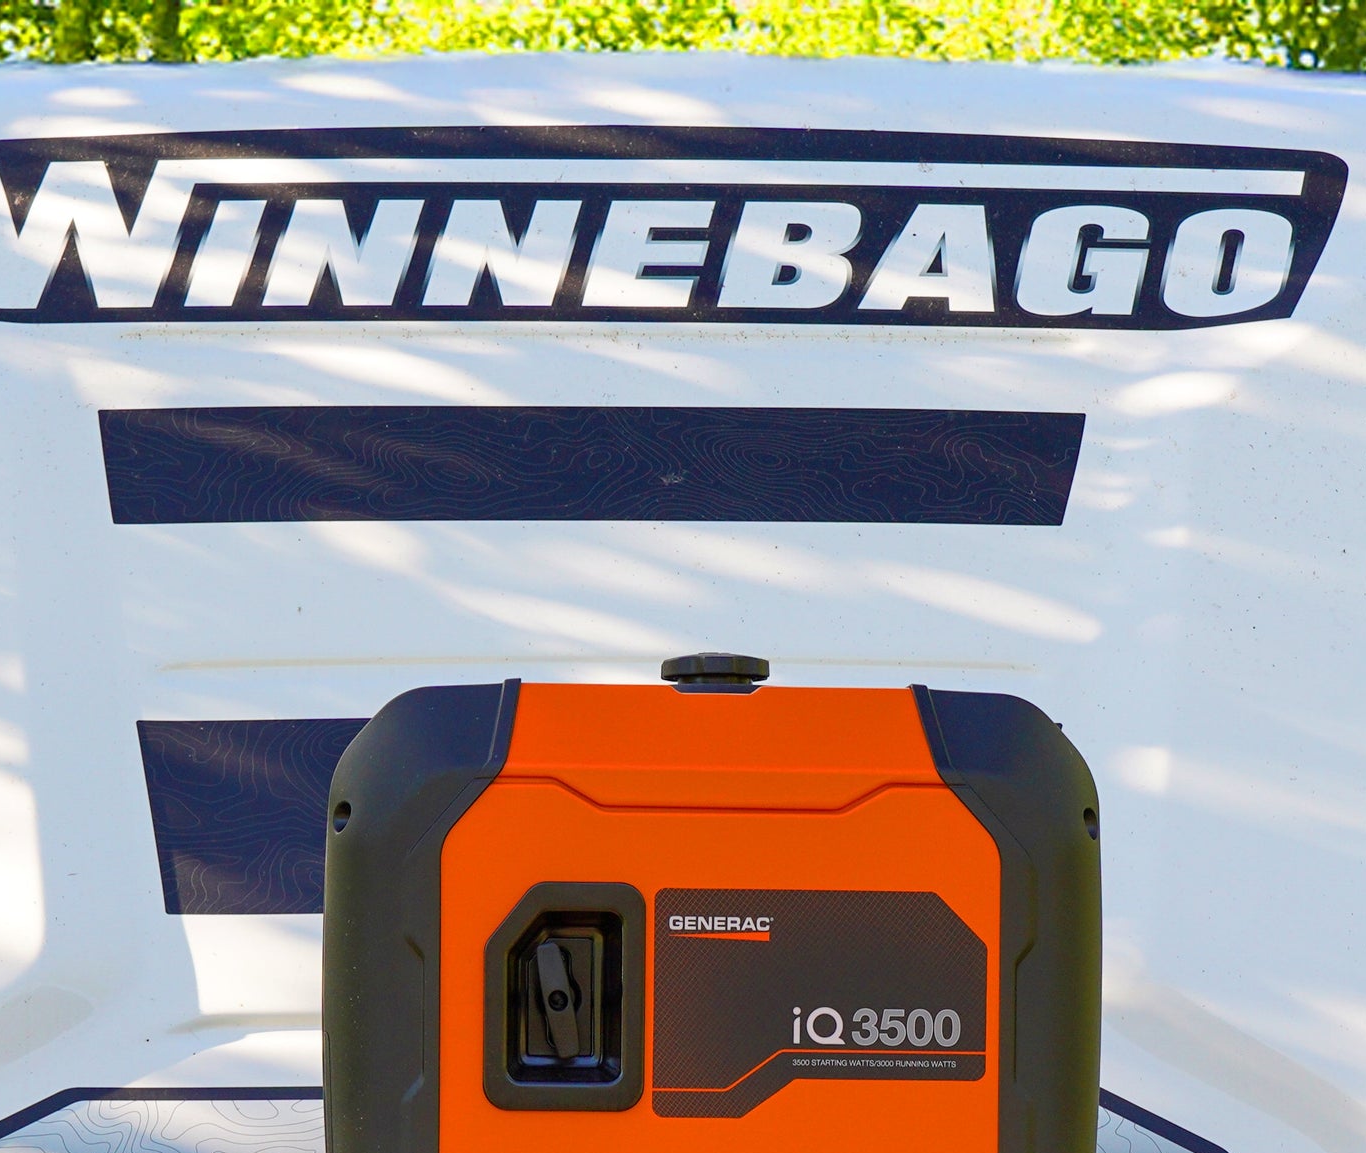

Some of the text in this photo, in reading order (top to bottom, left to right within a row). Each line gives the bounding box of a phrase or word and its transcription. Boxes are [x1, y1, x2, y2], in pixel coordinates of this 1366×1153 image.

[668, 915, 771, 932] GENERAC
[792, 1006, 961, 1047] iQ 3500
[792, 1059, 957, 1068] 3500 STARTING WATTS/3000 RUNNING WATTS
